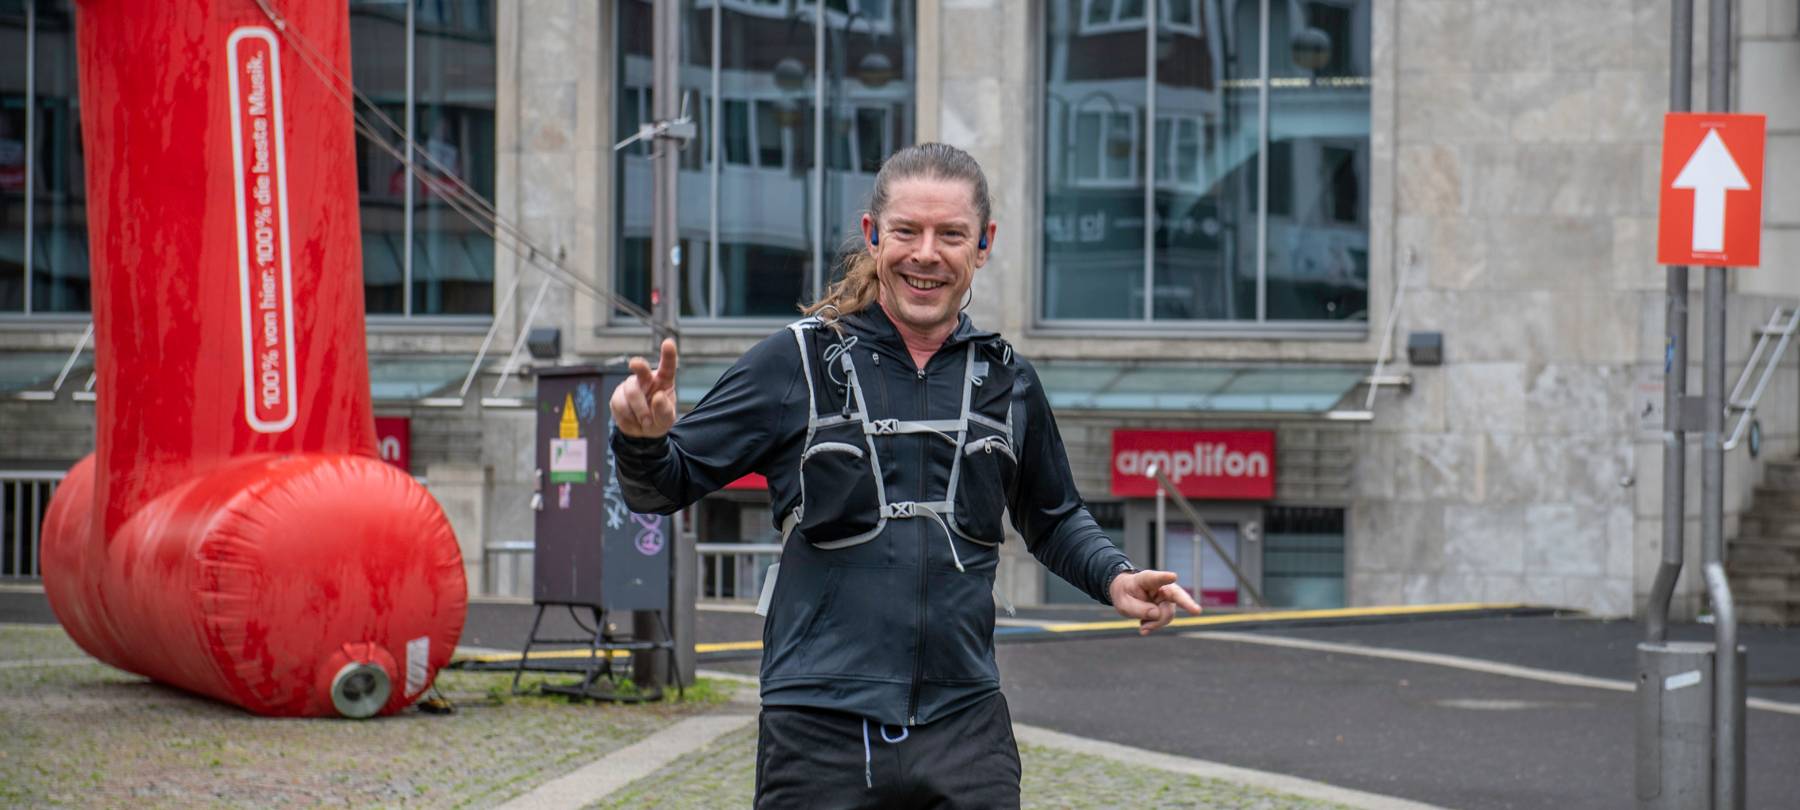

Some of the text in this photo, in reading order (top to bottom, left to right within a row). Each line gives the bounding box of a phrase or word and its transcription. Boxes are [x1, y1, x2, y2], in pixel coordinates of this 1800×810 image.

[246, 50, 281, 410] 100% von hier. 100% die beste Musik.
[1116, 443, 1268, 483] amplifon
